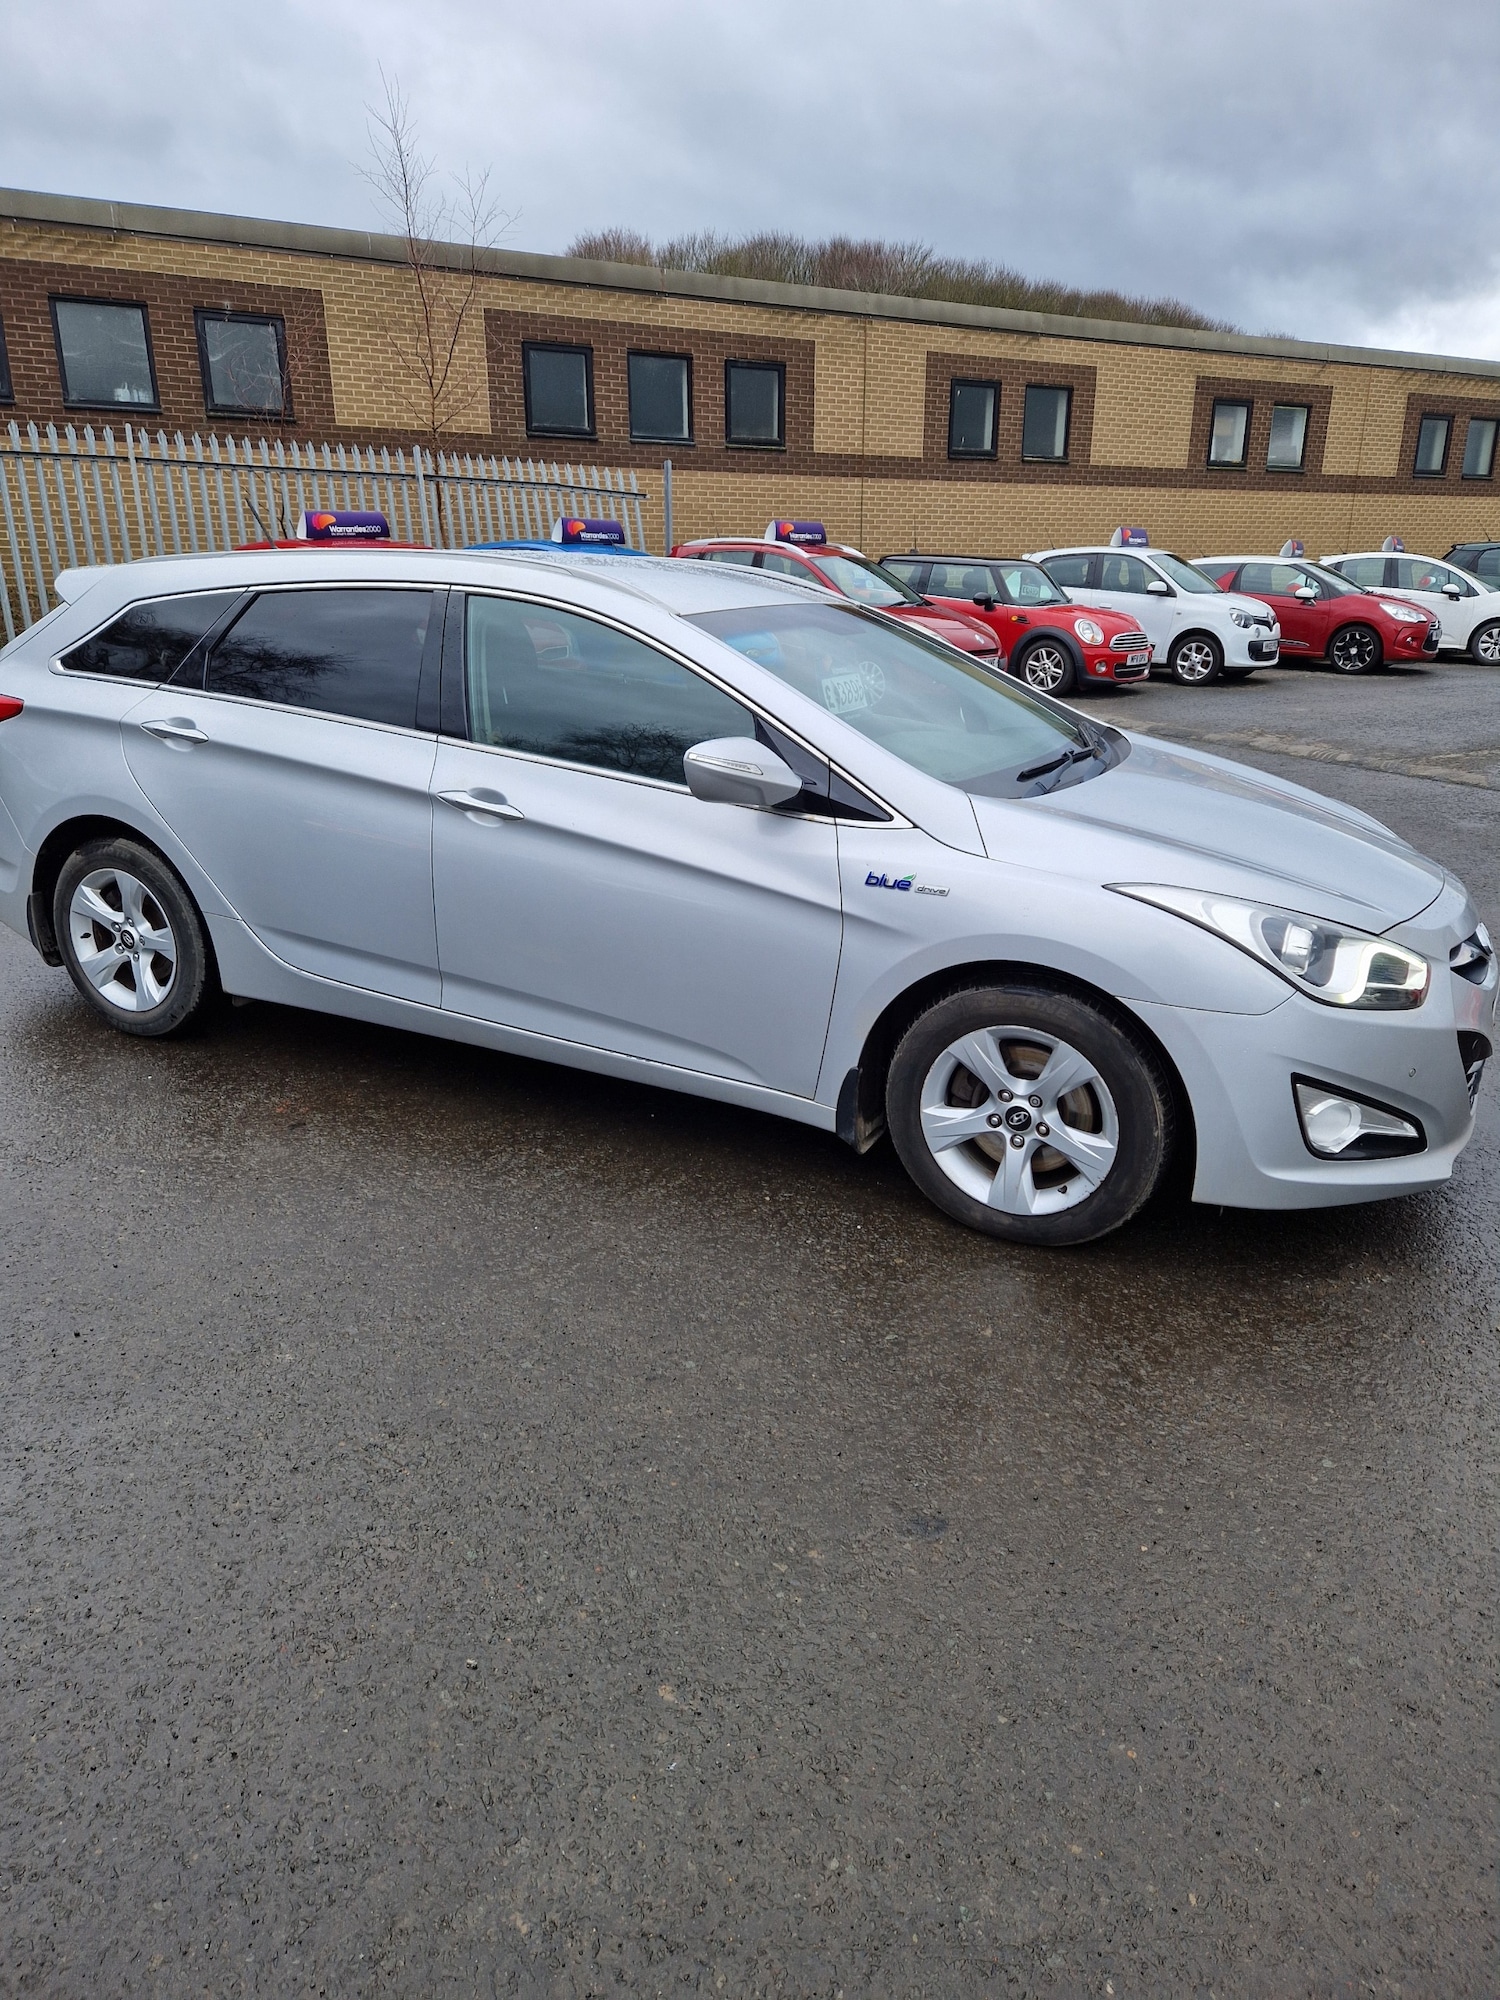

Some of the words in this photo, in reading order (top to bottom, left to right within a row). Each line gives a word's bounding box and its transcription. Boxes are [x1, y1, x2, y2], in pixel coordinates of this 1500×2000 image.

[329, 525, 381, 534] Warranties2000
[865, 871, 911, 891] blue
[917, 886, 946, 895] drive
